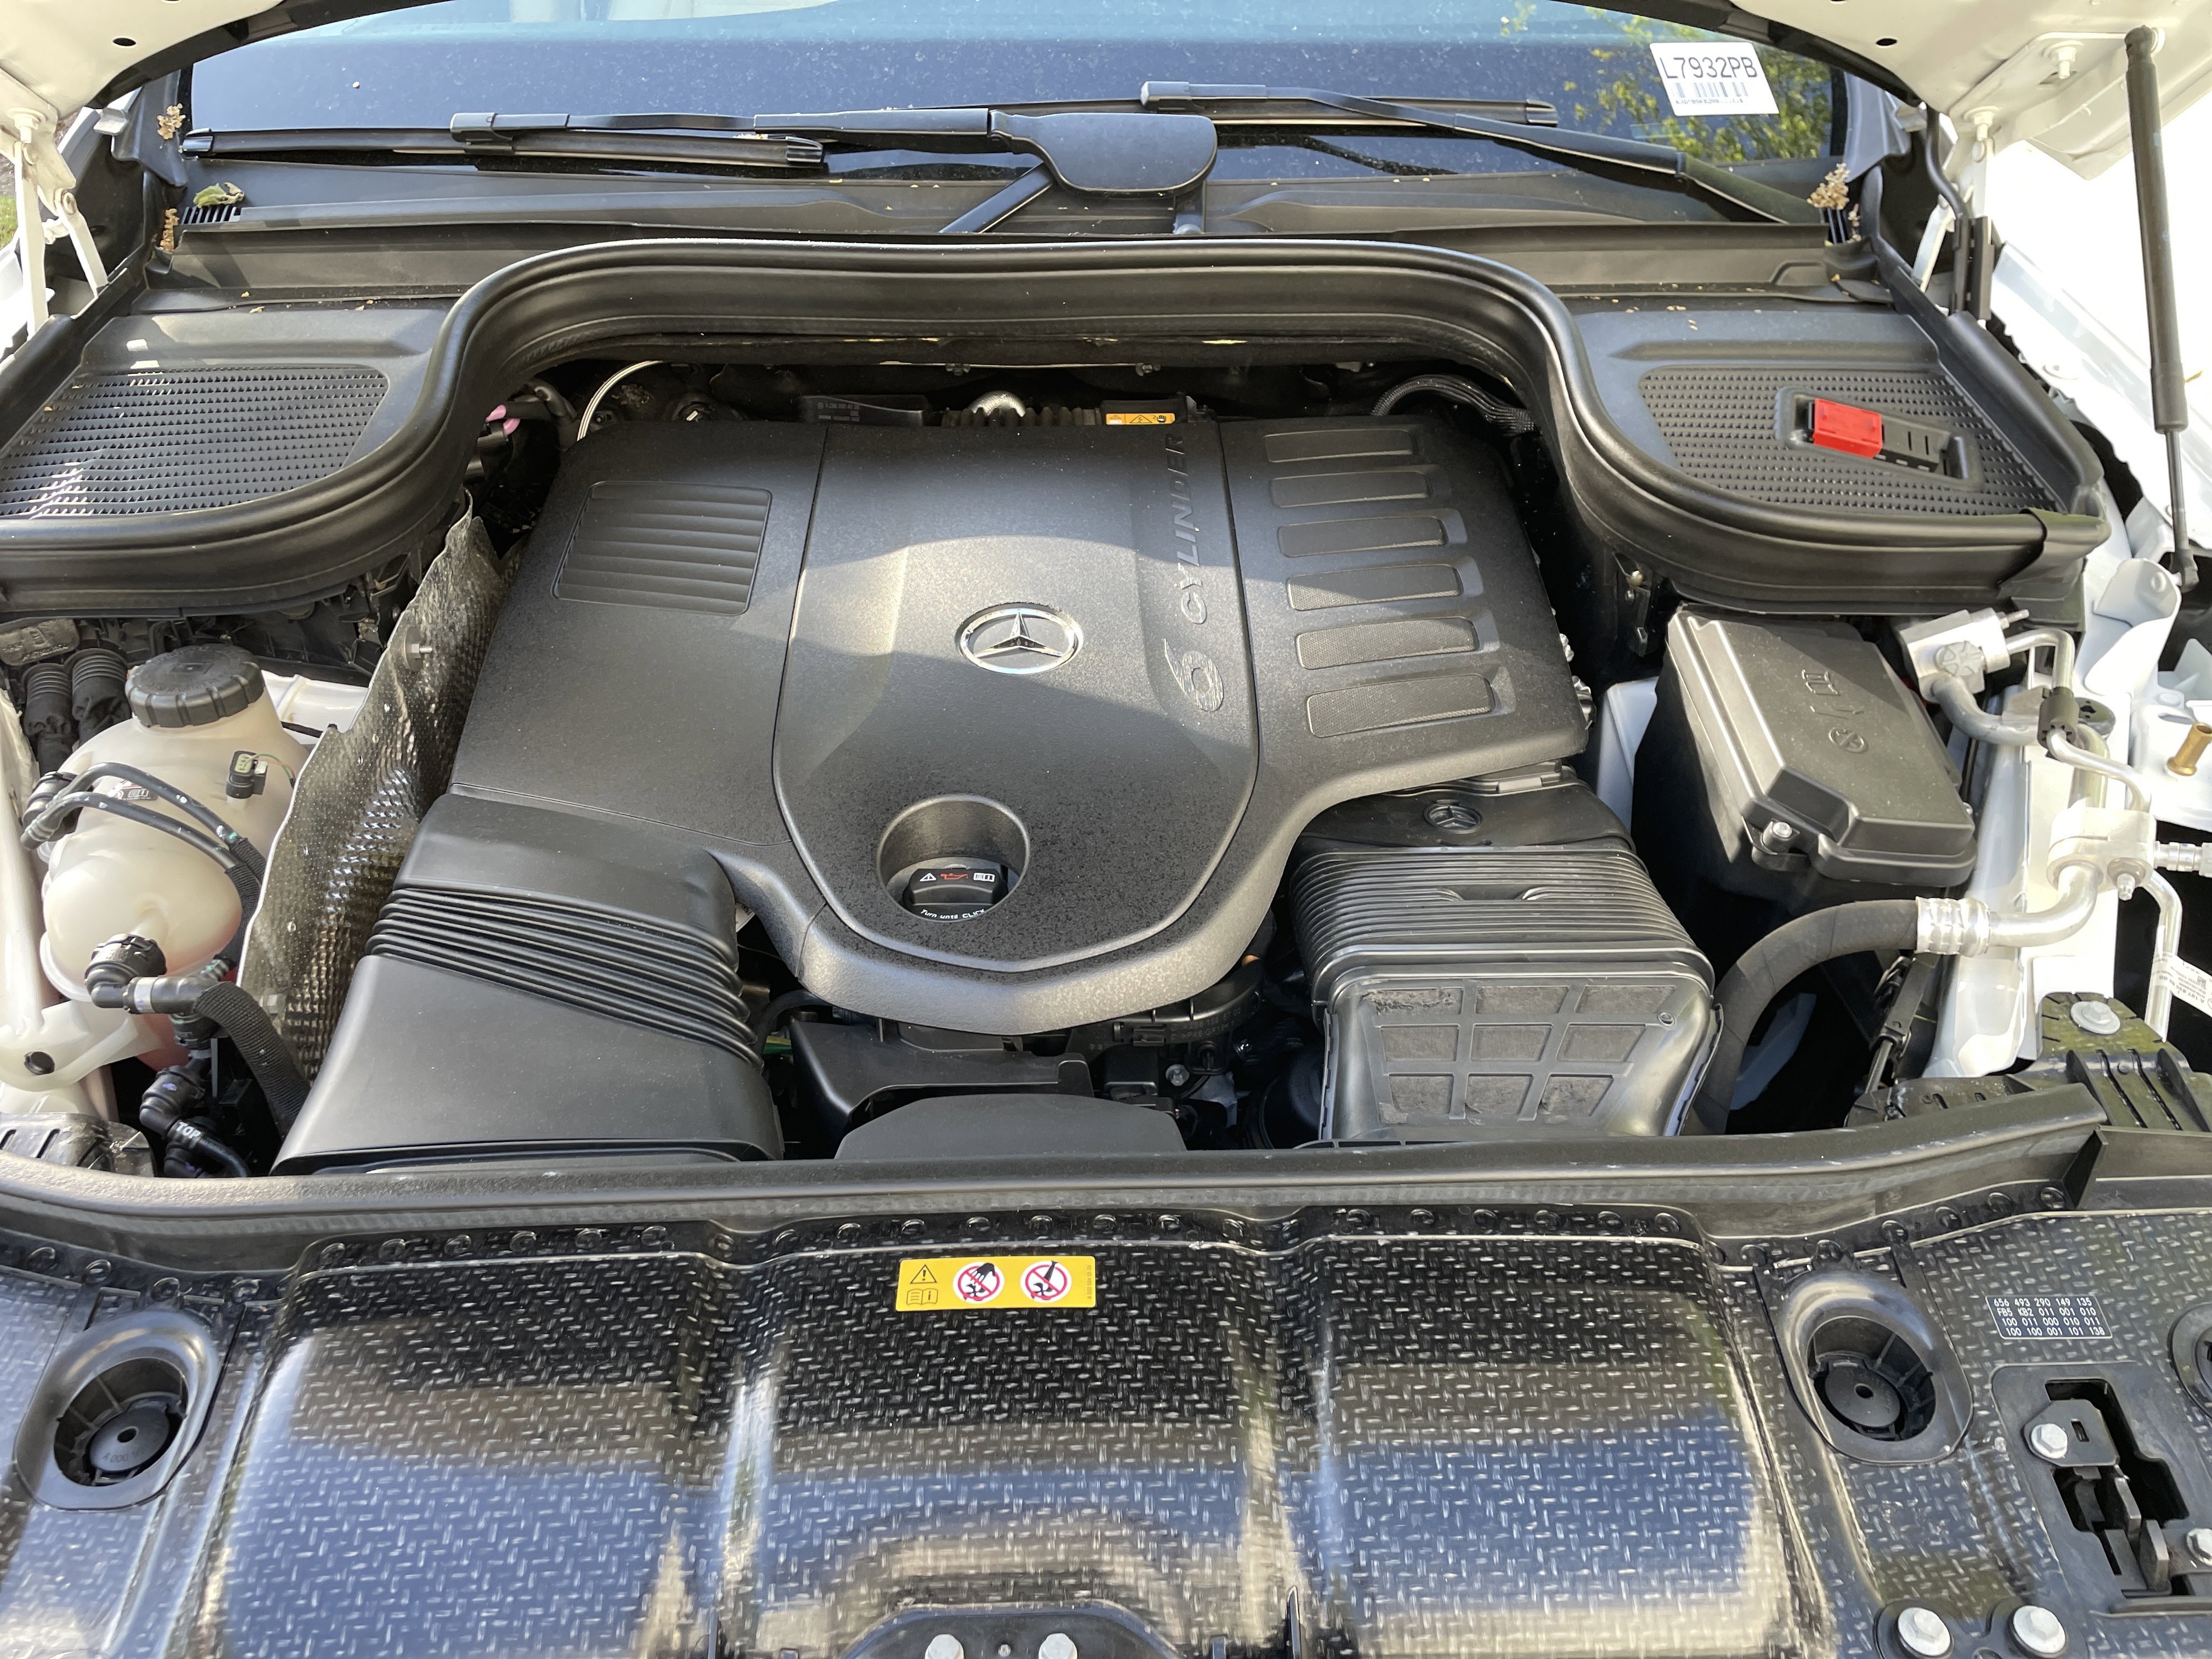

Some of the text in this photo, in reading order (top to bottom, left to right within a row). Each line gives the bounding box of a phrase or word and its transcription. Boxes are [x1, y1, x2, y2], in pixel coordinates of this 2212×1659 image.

[1659, 57, 1758, 80] L7932PB
[1164, 433, 1224, 712] 6 CYLINDER
[921, 909, 938, 918] Turn
[962, 909, 985, 918] CLICK
[176, 1121, 201, 1139] TOP
[1994, 1297, 2092, 1307] 656 493 290 149 135
[1997, 1307, 2096, 1317] FB5 KB2 011 001 010
[2002, 1317, 2100, 1326] 100 011 000 010 011
[2006, 1327, 2022, 1336] 100
[2027, 1327, 2042, 1336] 100
[2046, 1327, 2063, 1336] 001
[2068, 1327, 2084, 1335] 101
